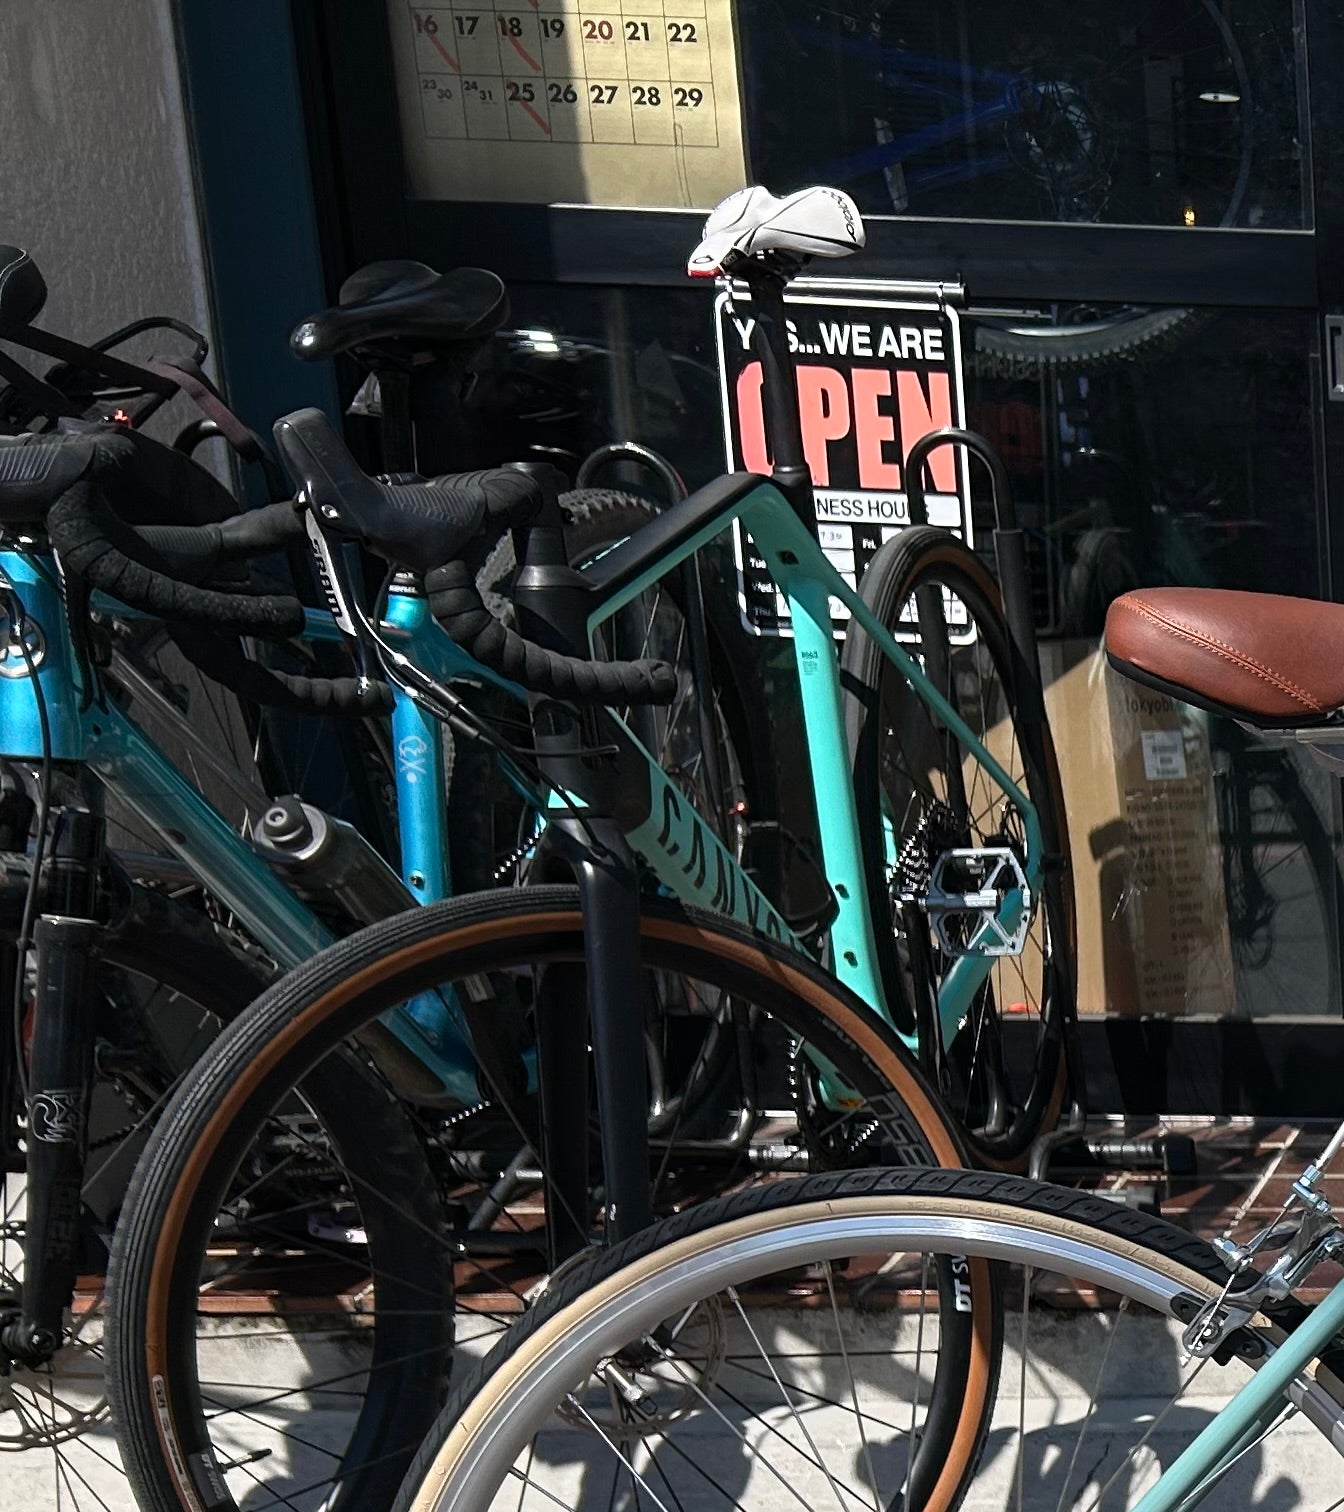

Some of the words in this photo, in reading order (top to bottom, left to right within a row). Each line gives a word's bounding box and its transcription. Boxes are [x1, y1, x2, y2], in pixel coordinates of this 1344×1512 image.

[413, 14, 439, 35] 16
[455, 16, 480, 36] 17
[498, 17, 523, 37] 18
[540, 18, 565, 39] 19
[582, 20, 614, 41] 20
[625, 21, 651, 42] 21
[667, 22, 698, 43] 22
[421, 79, 437, 90] 23
[463, 80, 478, 92] 24
[507, 82, 535, 102] 25
[548, 84, 578, 104] 26
[590, 85, 619, 105] 27
[631, 86, 661, 107] 28
[673, 87, 703, 108] 29
[437, 88, 452, 101] 30
[479, 90, 493, 102] 31
[878, 325, 945, 361] ARE
[954, 1278, 973, 1313] DT
